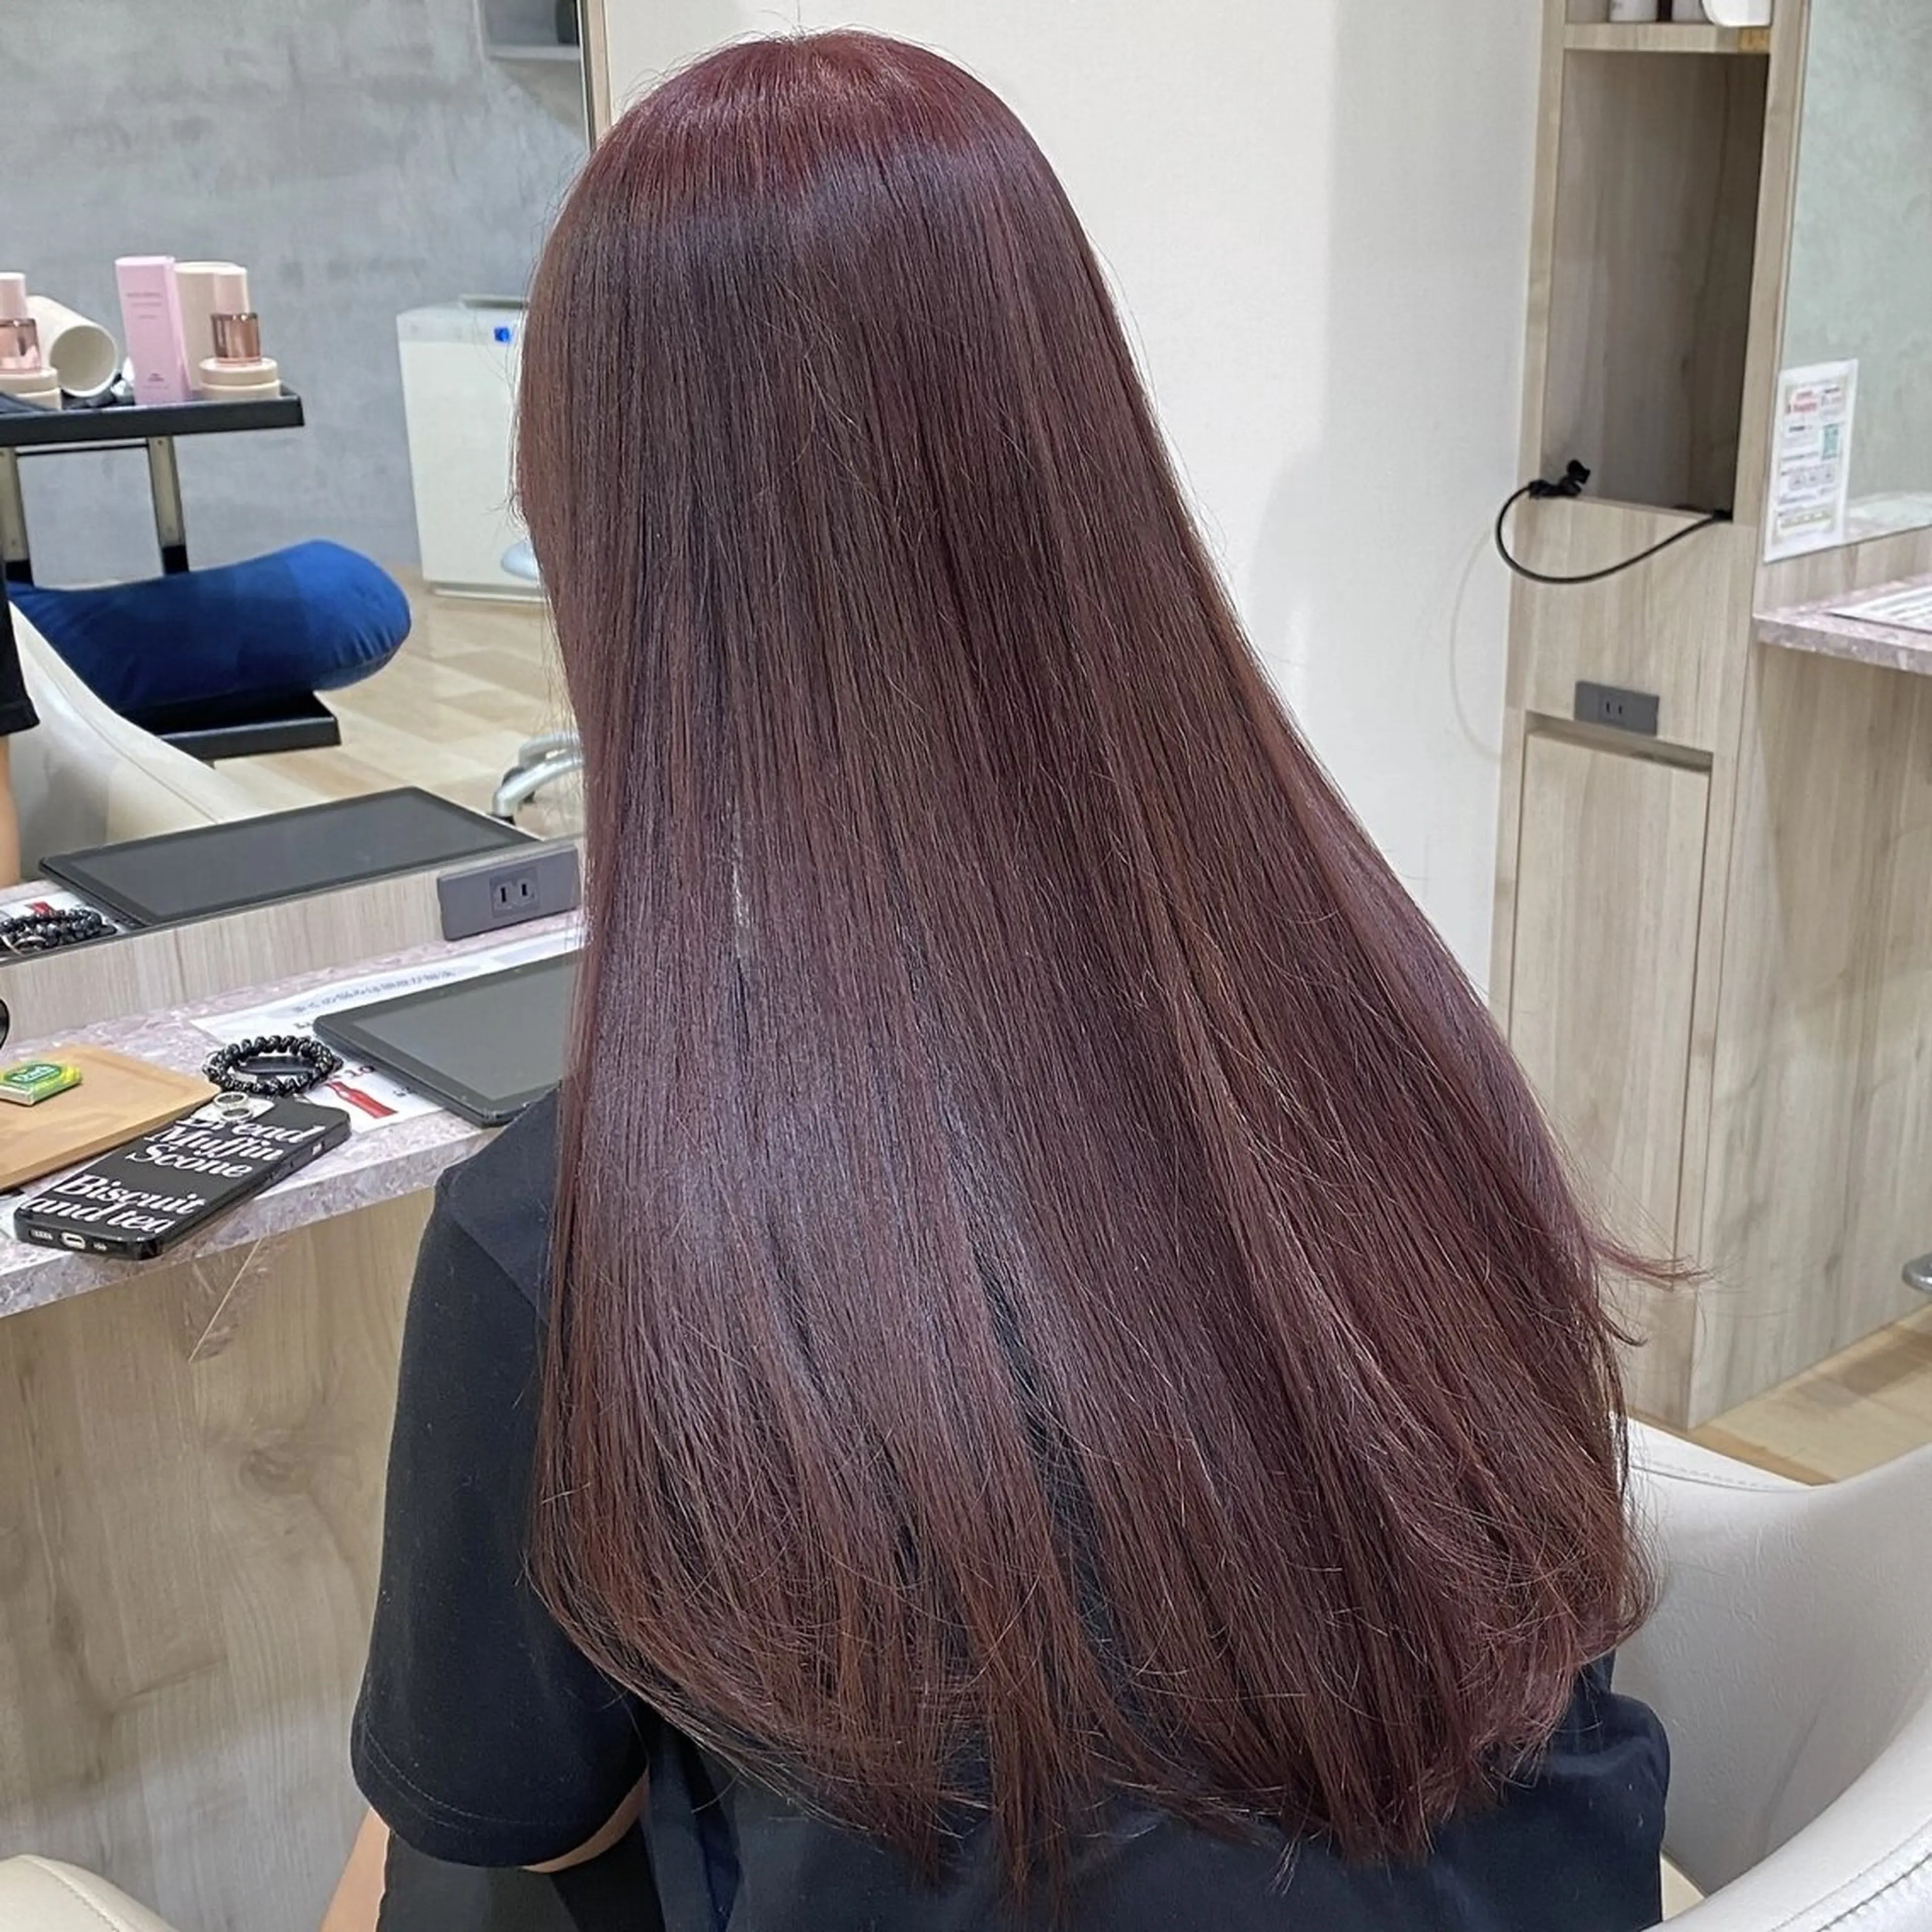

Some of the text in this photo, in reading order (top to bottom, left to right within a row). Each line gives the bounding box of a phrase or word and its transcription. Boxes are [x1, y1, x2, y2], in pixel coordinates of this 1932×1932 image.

[144, 1124, 284, 1161] Muffin
[126, 1144, 253, 1178] Scone
[53, 1174, 207, 1215] Biscuit
[20, 1198, 176, 1234] and tea
